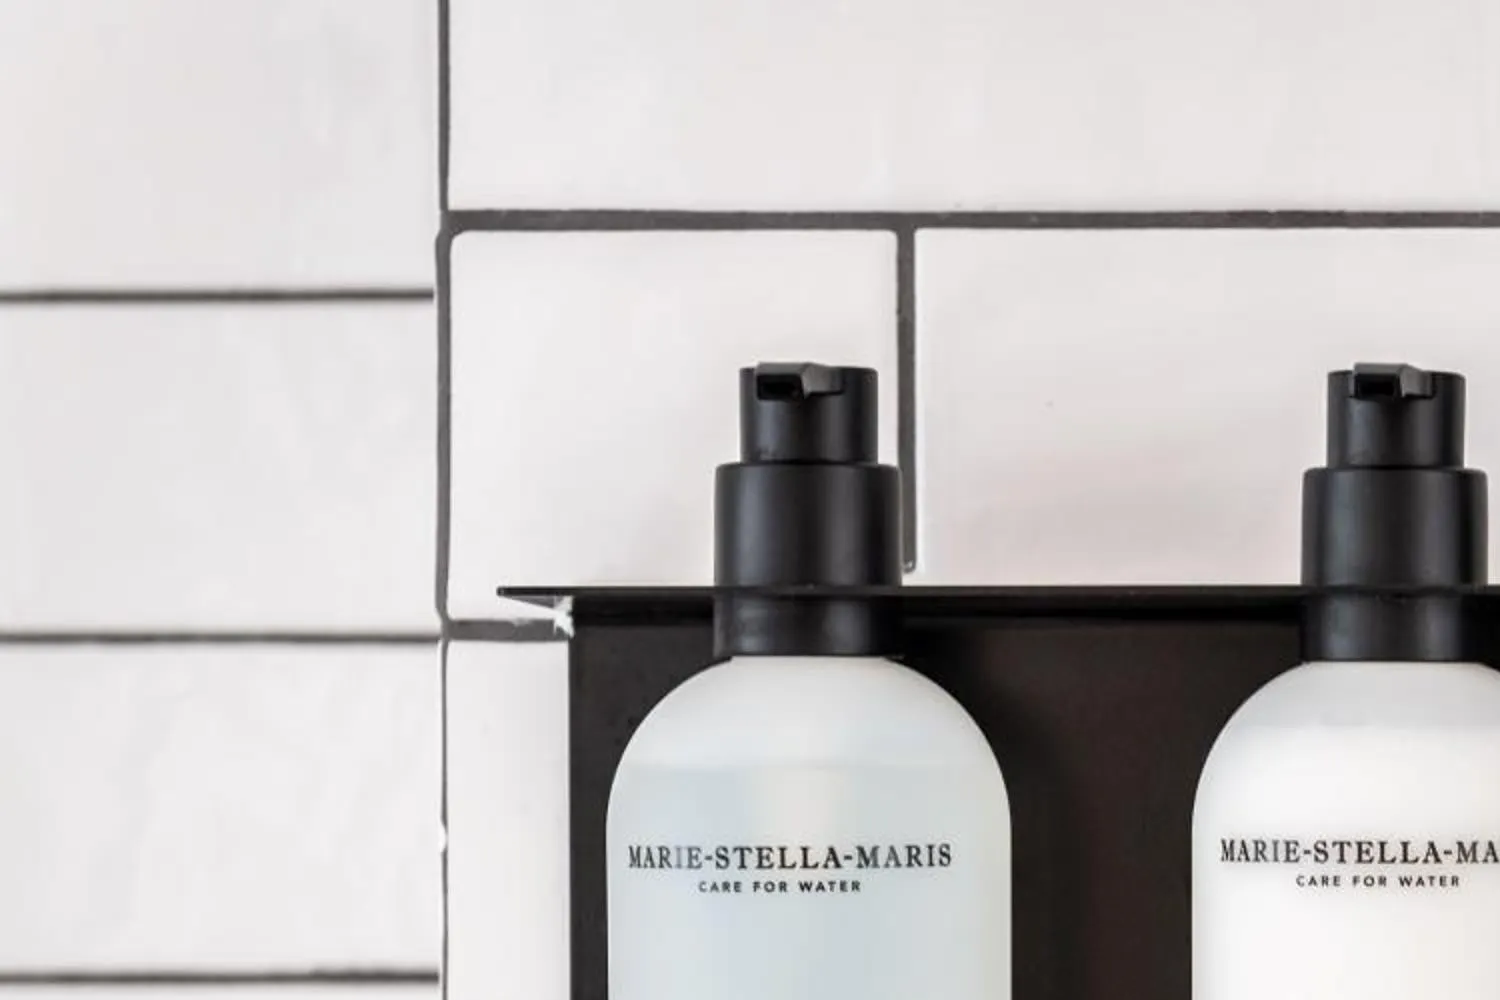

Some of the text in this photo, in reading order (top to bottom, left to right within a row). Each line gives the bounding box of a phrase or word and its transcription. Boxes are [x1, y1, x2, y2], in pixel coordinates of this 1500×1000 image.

[628, 843, 952, 870] MARIE-STELLA-MARIS
[698, 880, 861, 893] CARE FOR WATER
[1296, 874, 1461, 888] CARE FOR WATER
